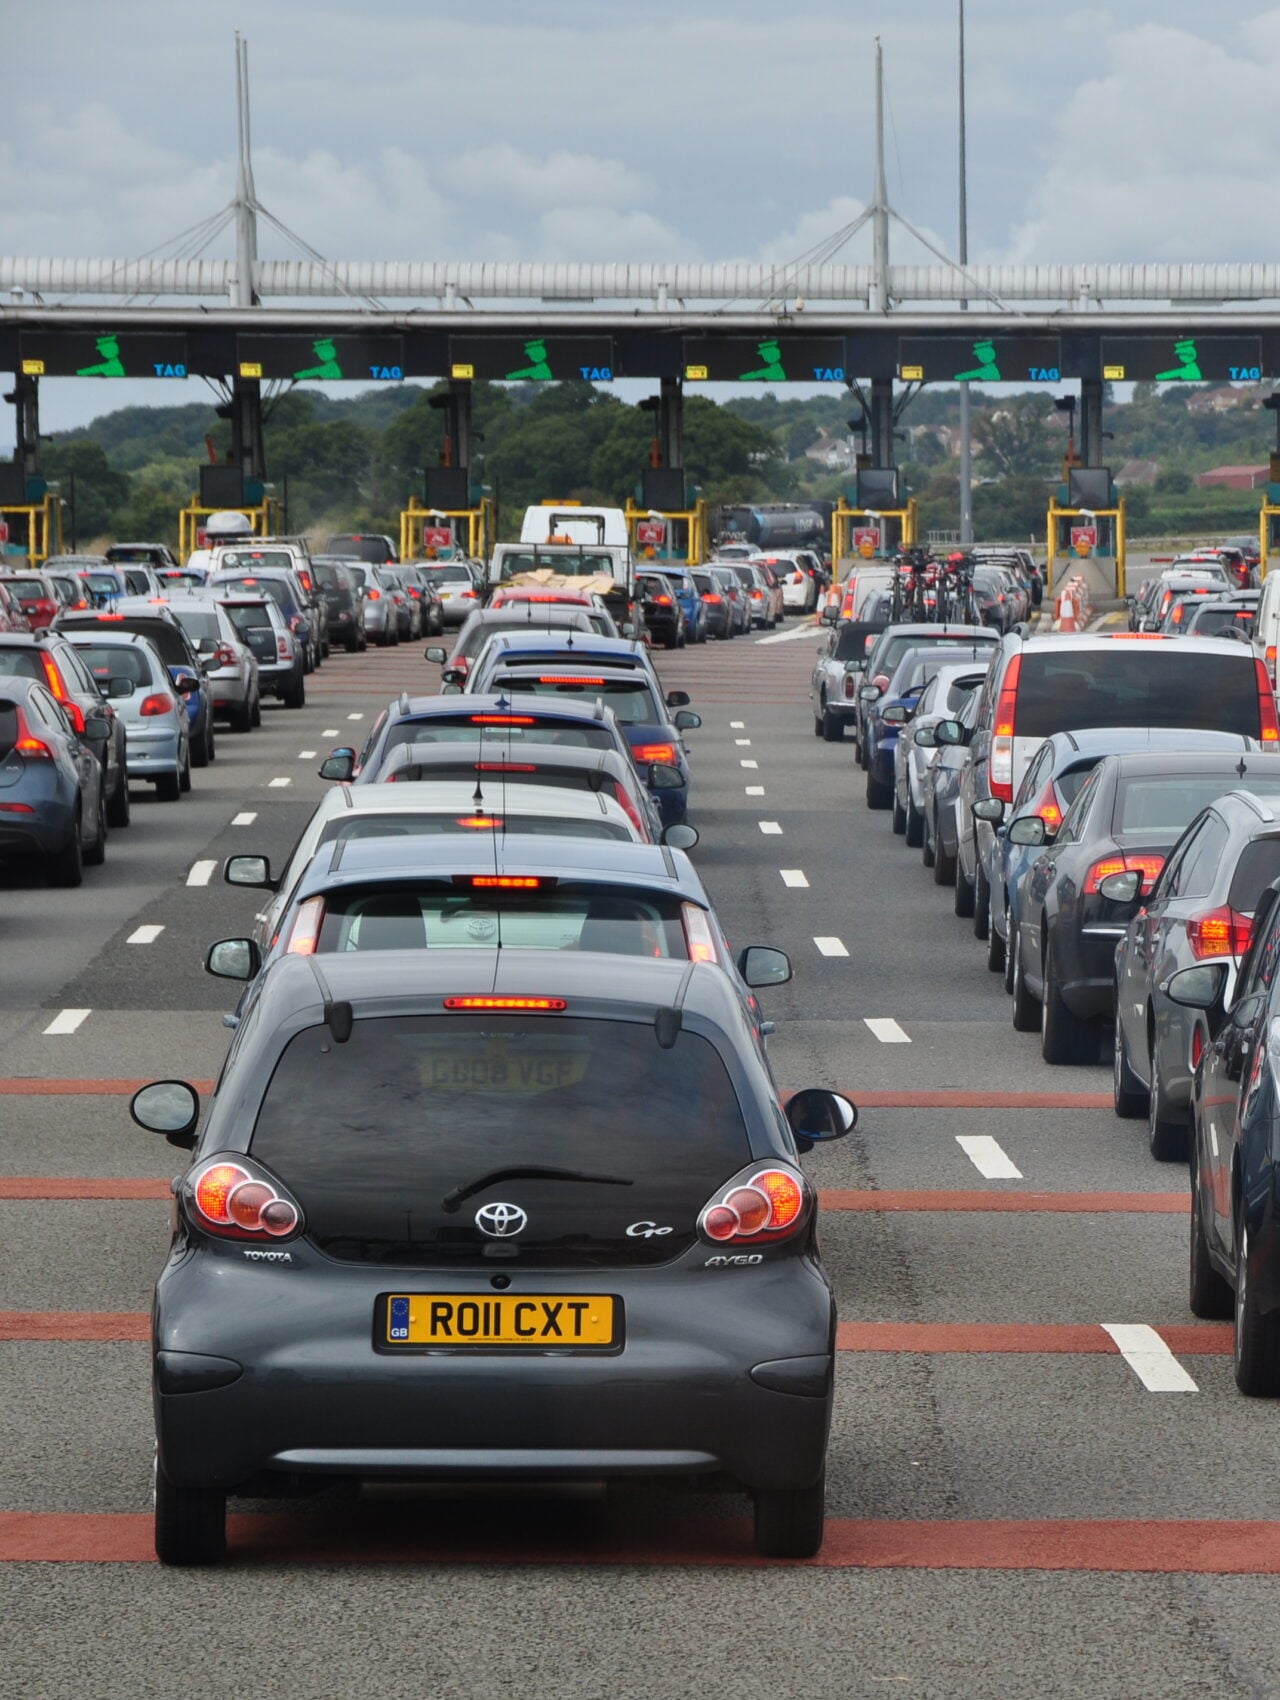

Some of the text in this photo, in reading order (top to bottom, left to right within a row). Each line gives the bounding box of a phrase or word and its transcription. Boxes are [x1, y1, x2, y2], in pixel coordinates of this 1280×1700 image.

[153, 364, 186, 379] TAG
[369, 366, 403, 381] TAG
[579, 367, 612, 381] TAG
[813, 367, 845, 382] TAG
[1028, 367, 1061, 382] TAG
[1228, 367, 1261, 381] TAG
[625, 1221, 674, 1238] Go
[243, 1250, 292, 1262] TOYOTA
[704, 1254, 763, 1266] AYGO
[514, 1302, 590, 1336] CXT
[391, 1328, 408, 1337] GB
